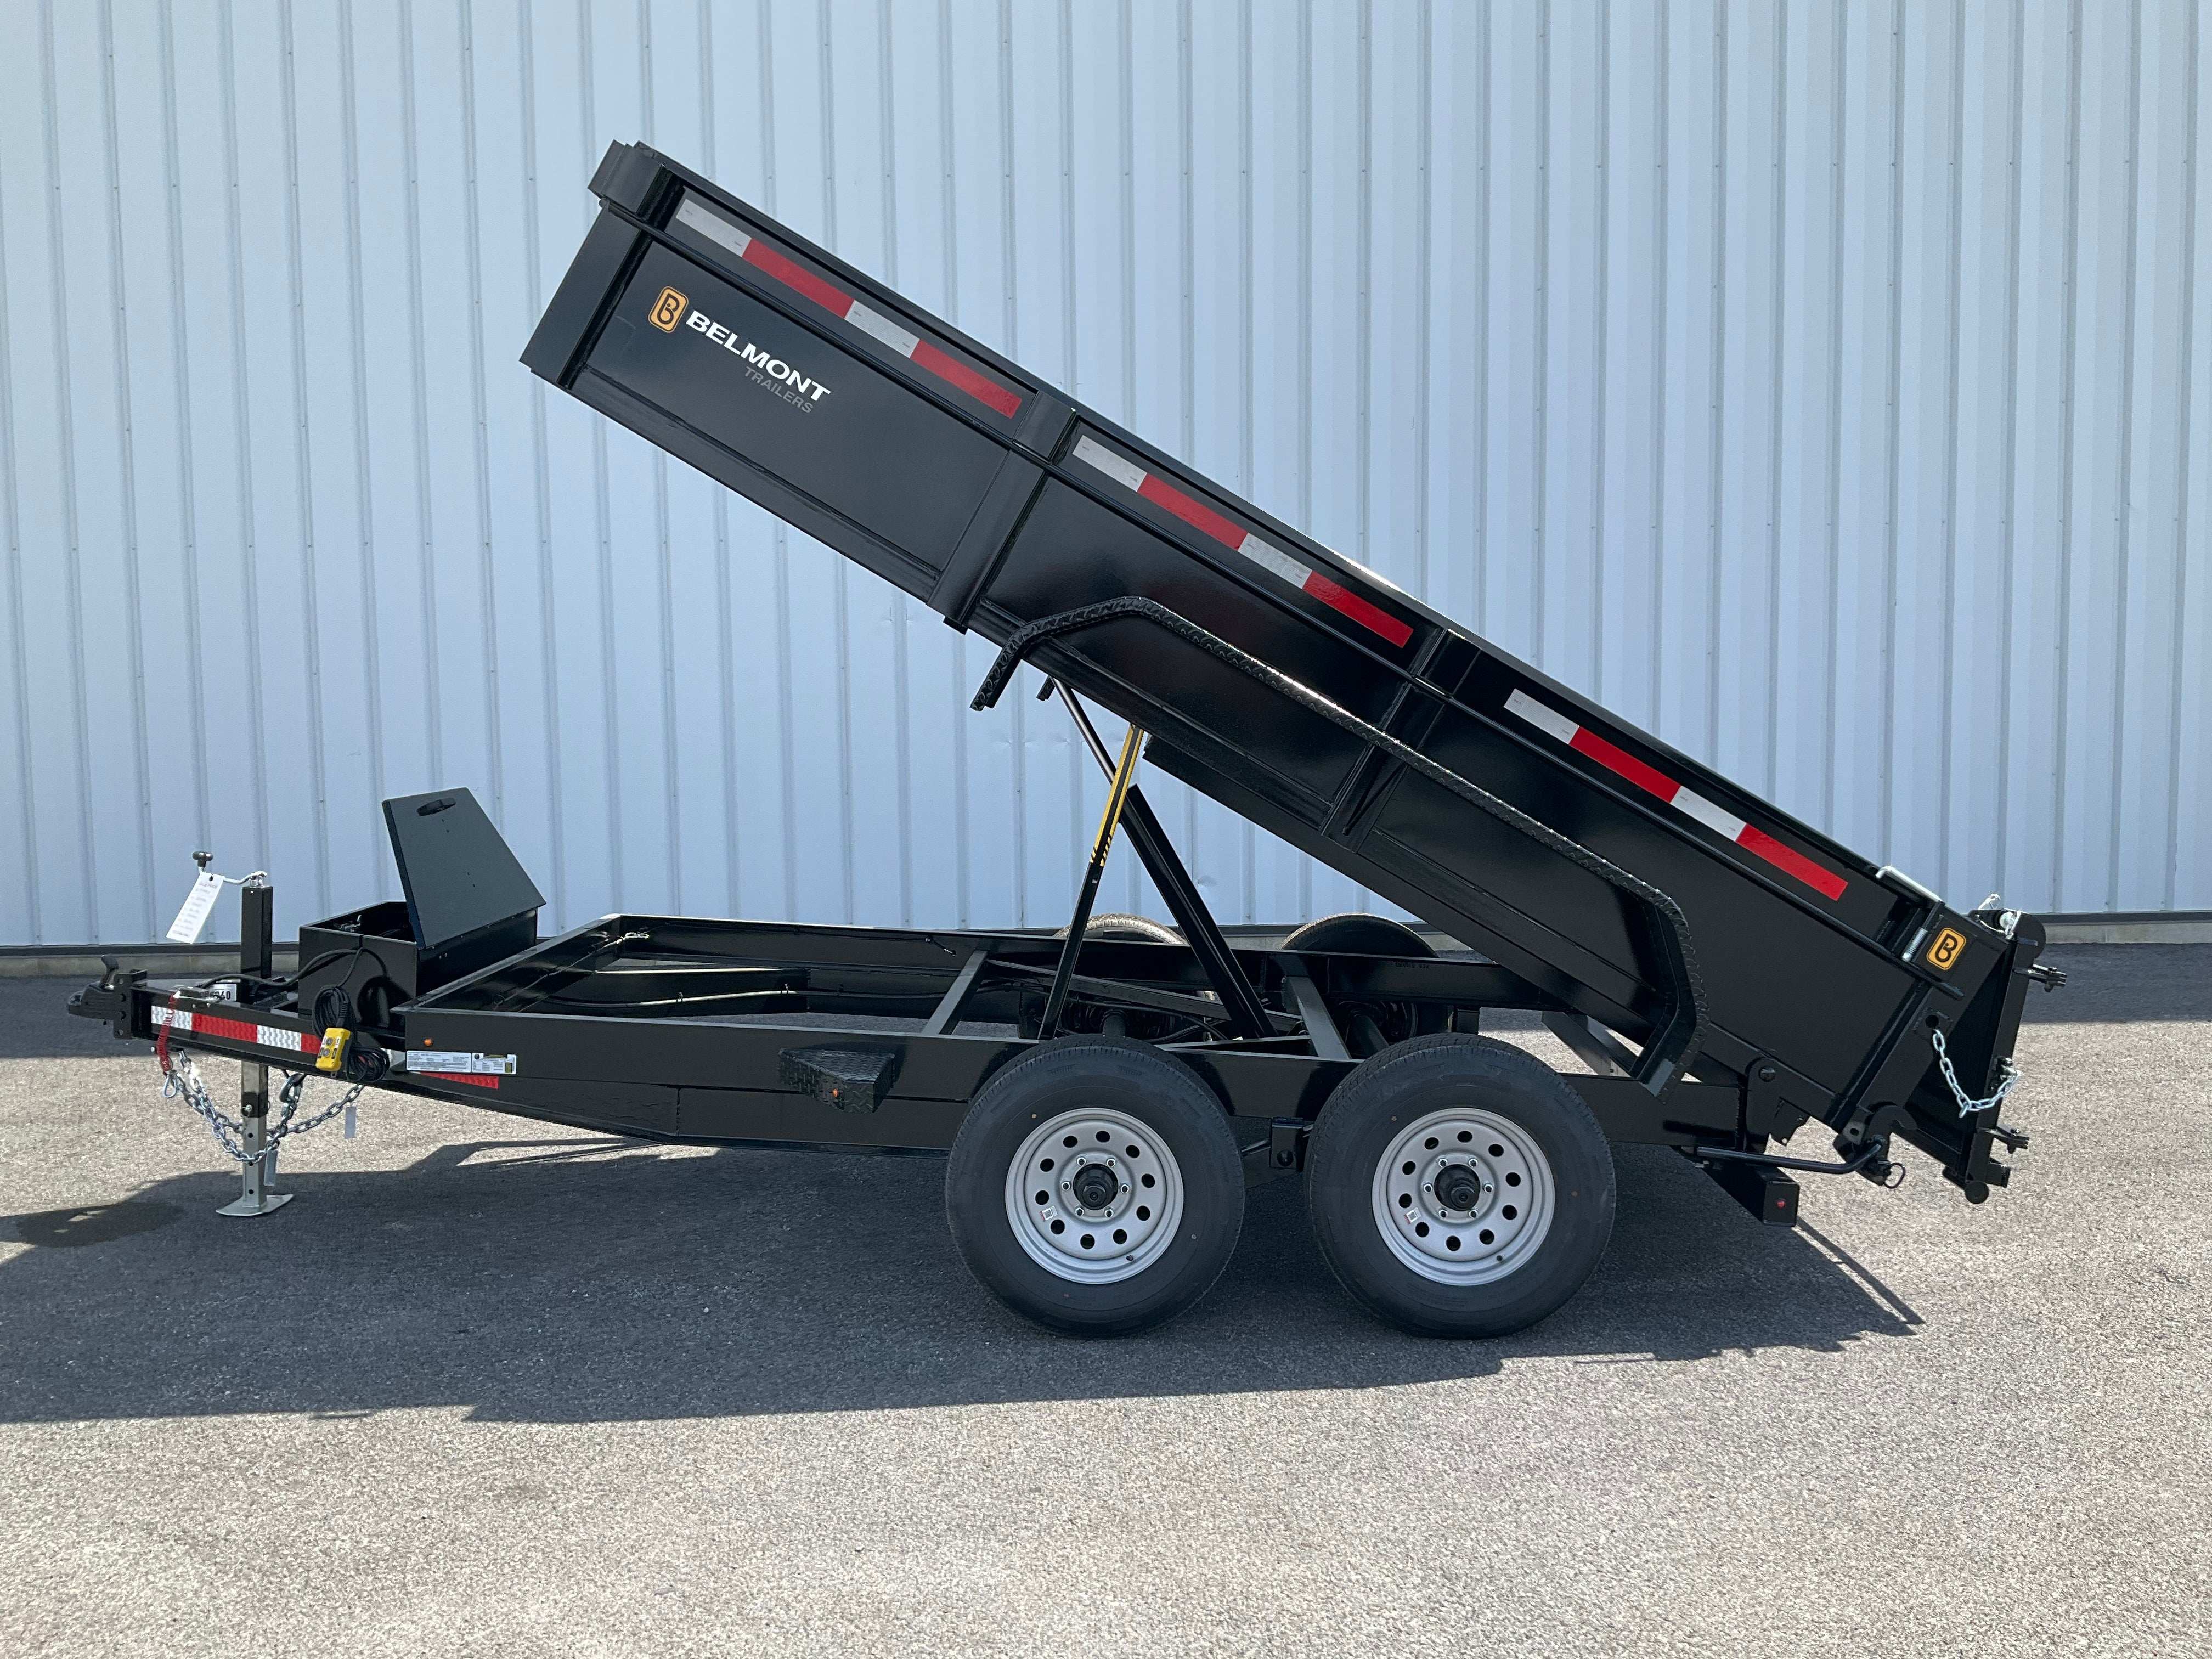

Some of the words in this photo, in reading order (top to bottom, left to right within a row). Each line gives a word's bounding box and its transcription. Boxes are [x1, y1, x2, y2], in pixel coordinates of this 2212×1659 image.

[657, 293, 680, 325] B
[686, 310, 831, 401] BELMONT
[744, 366, 814, 413] TRAILERS
[1934, 933, 1957, 963] B
